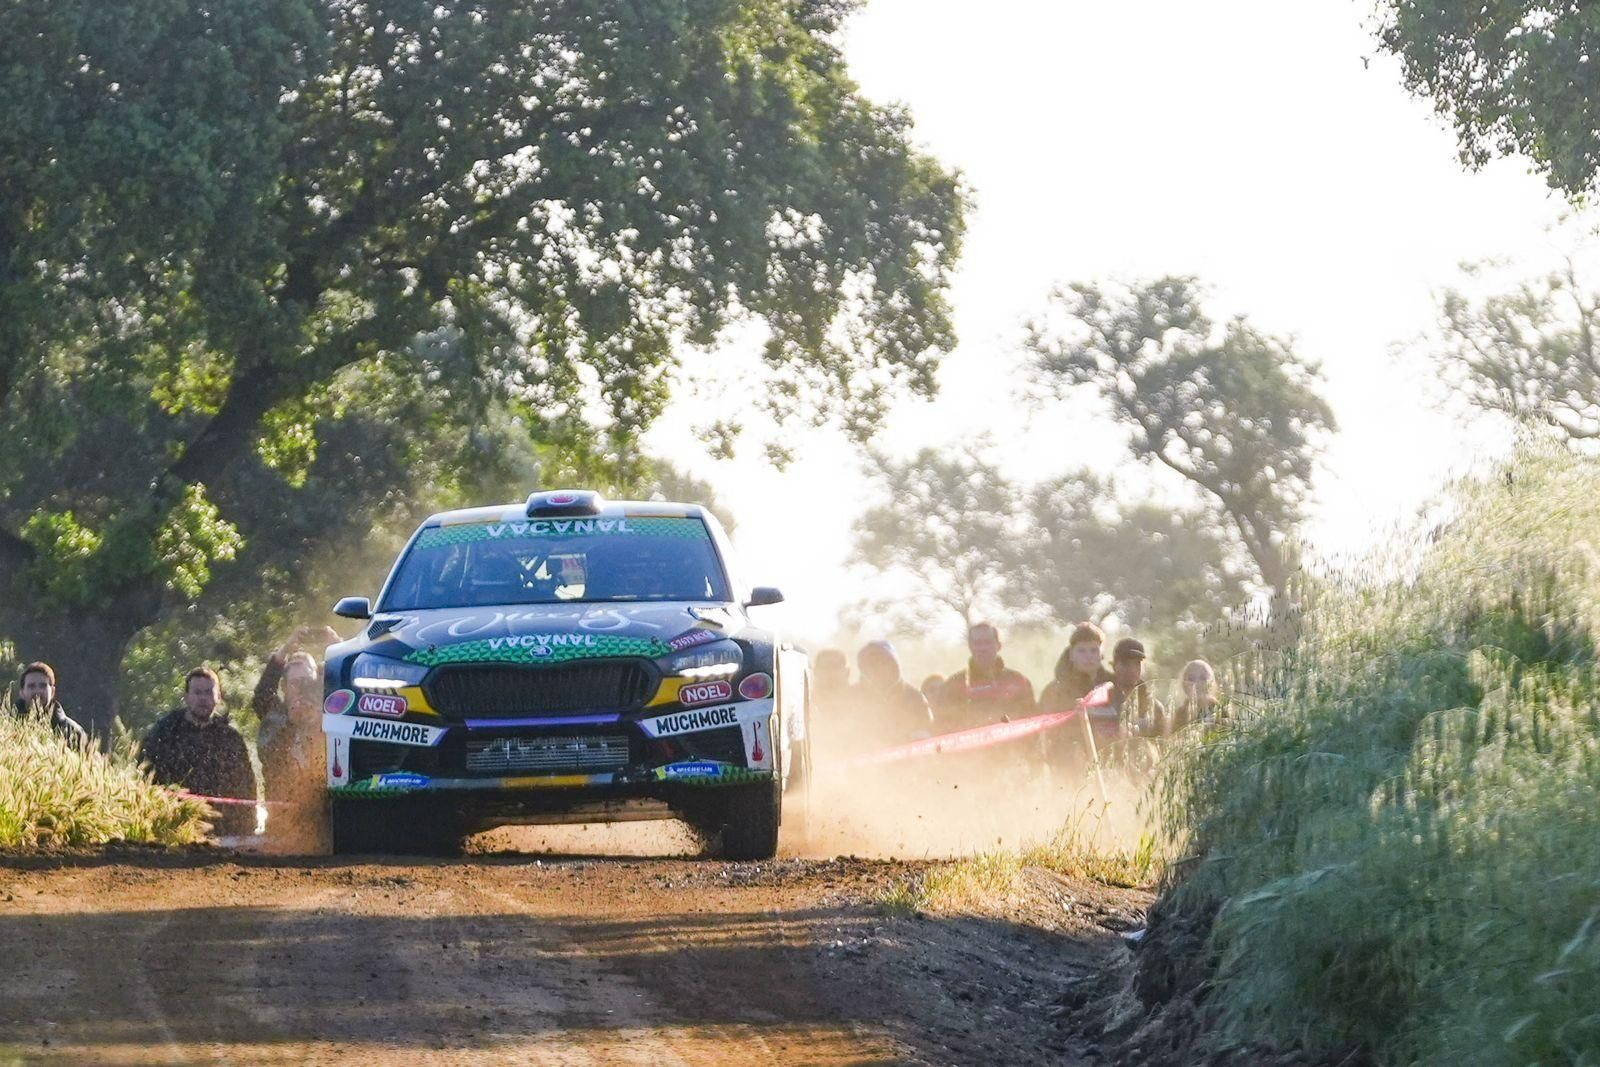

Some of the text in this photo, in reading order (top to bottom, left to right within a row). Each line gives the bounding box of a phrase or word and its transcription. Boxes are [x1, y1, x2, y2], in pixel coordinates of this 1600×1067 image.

[685, 684, 726, 702] NOEL
[363, 697, 399, 714] NOEL
[656, 707, 738, 735] MUCHMORE
[352, 720, 430, 744] MUCHMORE
